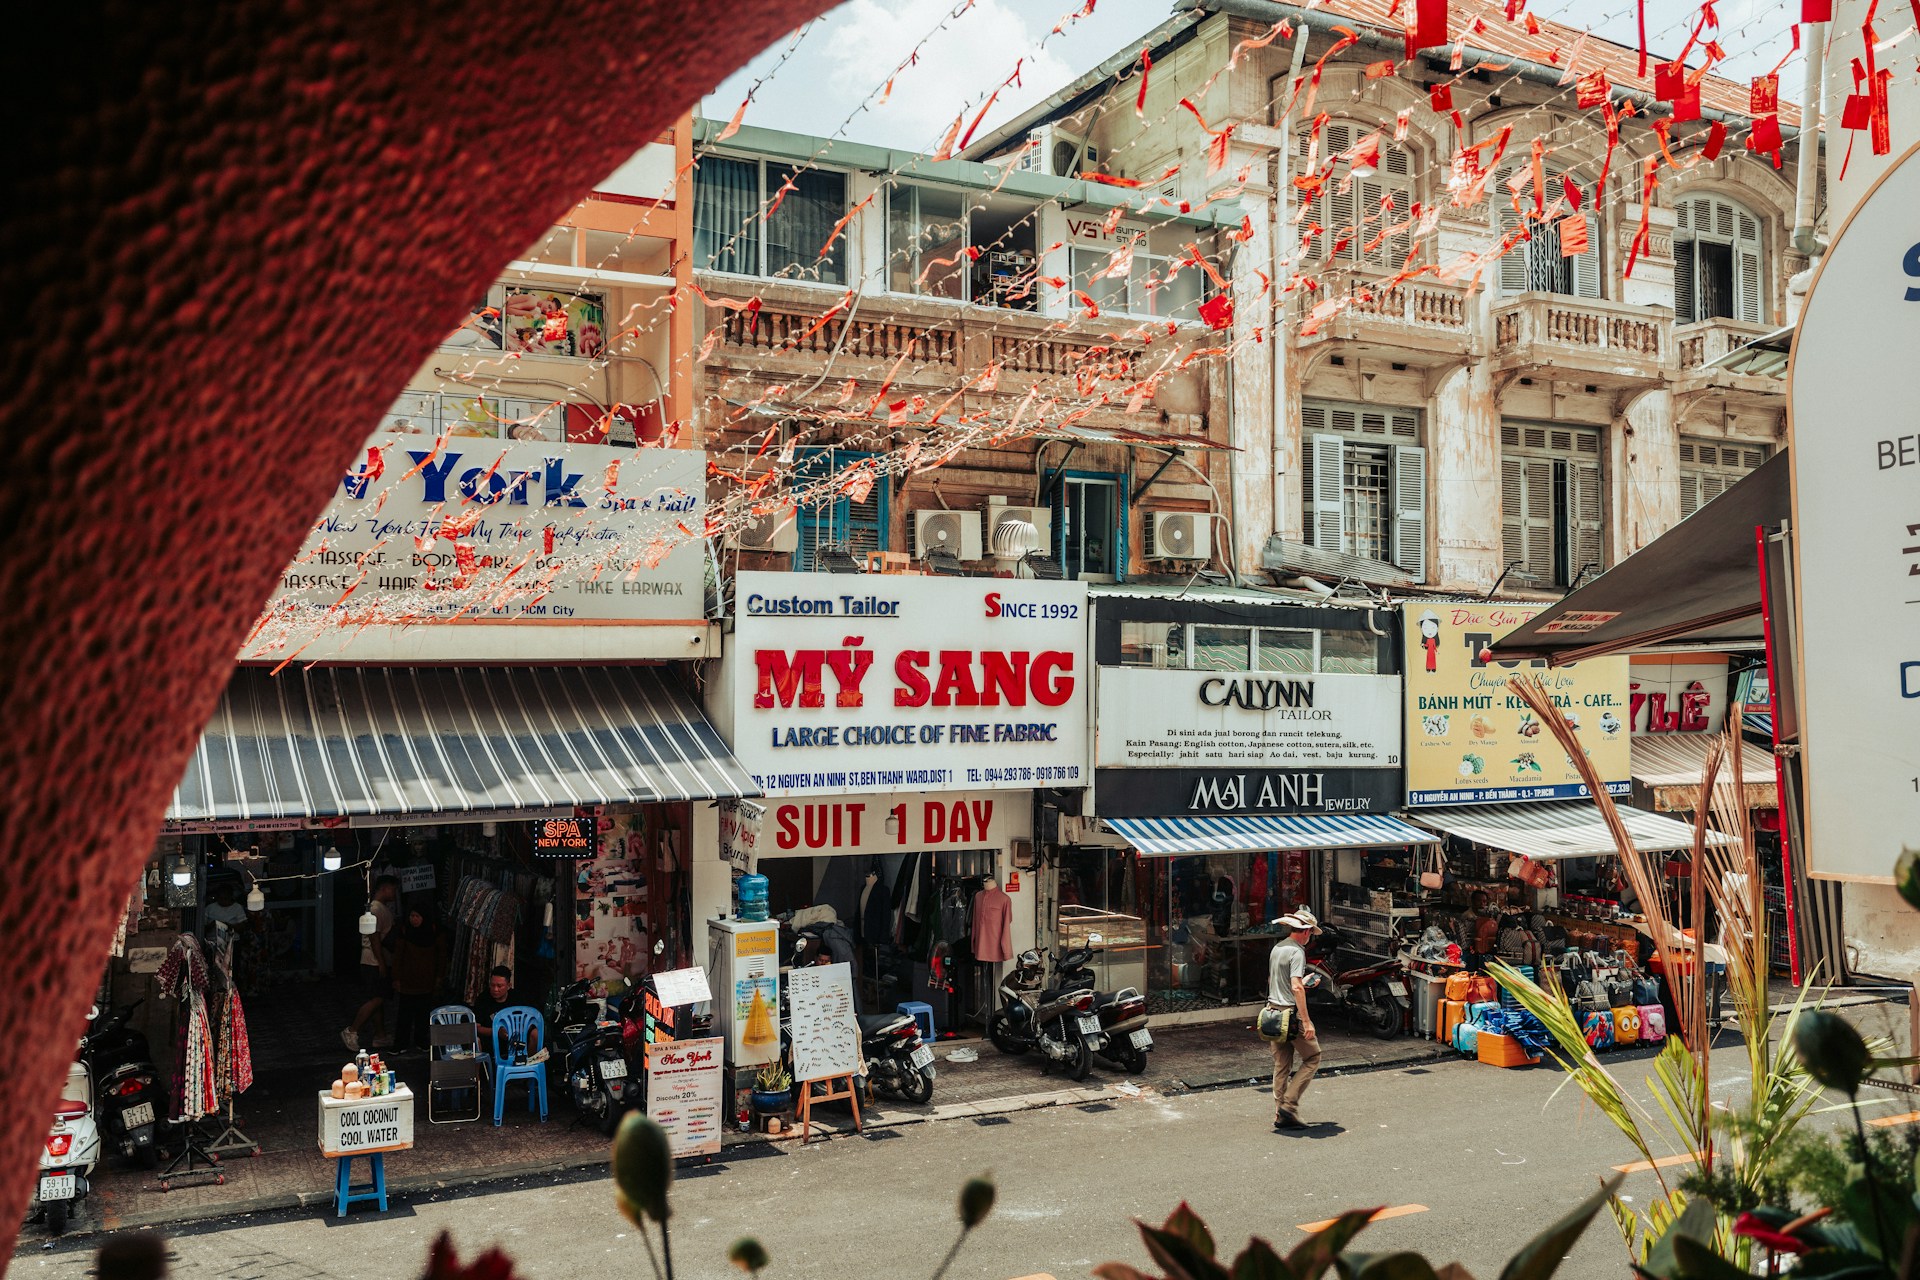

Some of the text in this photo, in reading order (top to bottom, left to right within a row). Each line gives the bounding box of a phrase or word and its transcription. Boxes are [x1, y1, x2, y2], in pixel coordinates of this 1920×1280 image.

[406, 450, 588, 507] York
[576, 581, 614, 594] TAKE
[622, 581, 683, 595] EARWAX
[553, 605, 575, 616] City
[747, 593, 899, 616] Custom Tailor
[984, 592, 1079, 619] SINCE 1992
[754, 635, 1075, 709] MỸ SANG
[1418, 693, 1458, 710] BÁNH
[1278, 709, 1332, 721] TAILOR
[772, 723, 1057, 748] LARGE CHOICE OF FINE FABRIC
[1214, 730, 1230, 738] jual
[1232, 731, 1260, 739] borong
[1306, 731, 1342, 739] telekung.
[1149, 740, 1182, 749] Pasang:
[1184, 740, 1216, 749] English
[1128, 751, 1175, 759] Especially:
[1179, 751, 1200, 759] jahit
[1247, 751, 1264, 760] siap
[1326, 752, 1343, 760] baju
[1388, 755, 1398, 764] 10
[766, 775, 776, 789] 12
[778, 773, 811, 788] NGUYEN
[813, 773, 825, 787] AN
[827, 773, 846, 787] NINH
[877, 771, 903, 784] THANH
[948, 770, 953, 783] 1
[967, 769, 982, 782] TEL:
[984, 768, 1003, 782] 0944
[1004, 767, 1018, 781] 293
[1018, 767, 1031, 780] 786
[1036, 766, 1052, 780] 0918
[1053, 766, 1066, 779] 766
[1066, 766, 1079, 779] 109
[1188, 773, 1371, 811] MAI ANH JEWELRY
[1449, 792, 1458, 801] AN
[1459, 792, 1475, 801] NINH
[545, 821, 581, 838] SPA
[776, 803, 865, 850] SUIT
[891, 803, 907, 845] 1
[924, 800, 993, 844] DAY
[538, 838, 587, 848] NEW YORK
[341, 1107, 398, 1127] COOL COCONUT
[341, 1127, 398, 1146] COOL WATER
[46, 1177, 69, 1189] 59-T1
